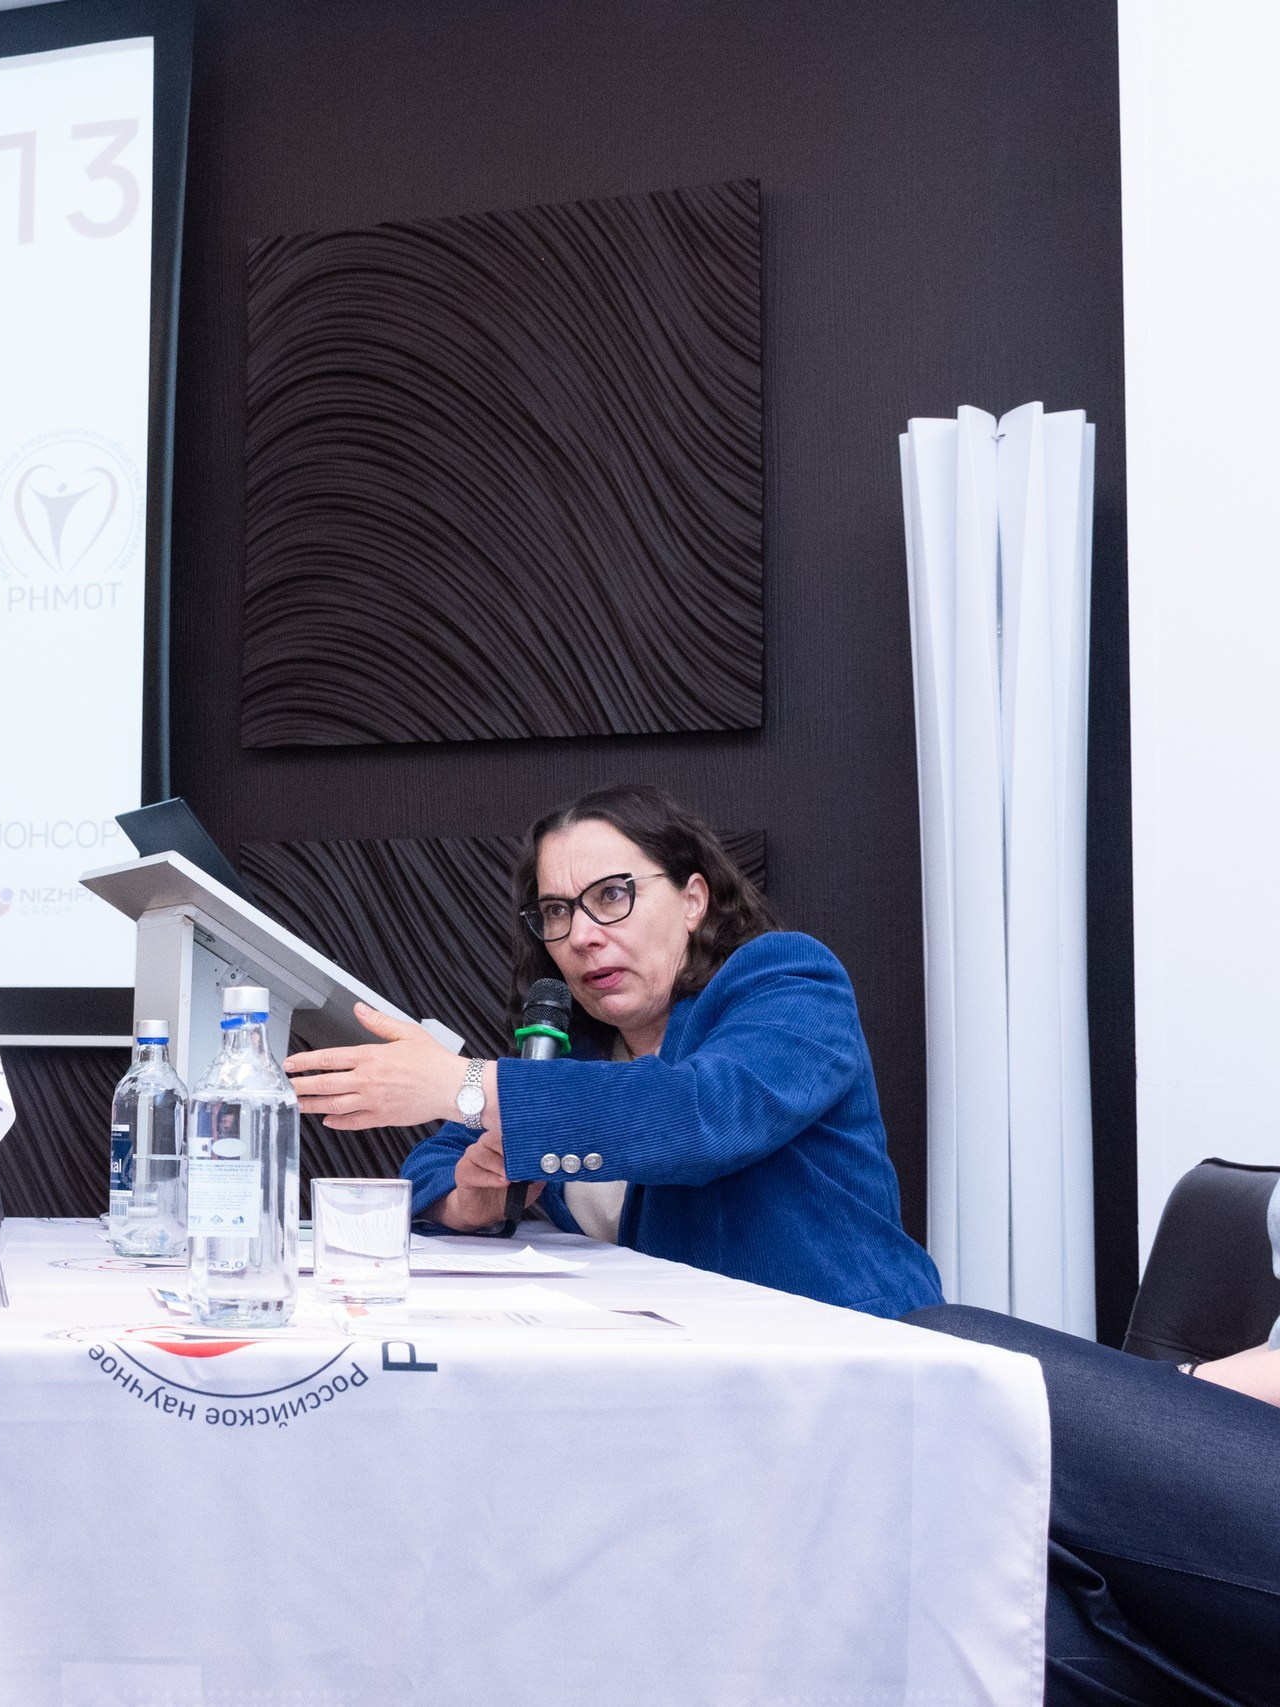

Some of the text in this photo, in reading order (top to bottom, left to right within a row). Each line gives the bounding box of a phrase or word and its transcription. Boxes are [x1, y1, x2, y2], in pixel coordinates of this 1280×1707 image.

[7, 581, 123, 613] РНМОТ
[87, 1344, 369, 1429] Российское научное
